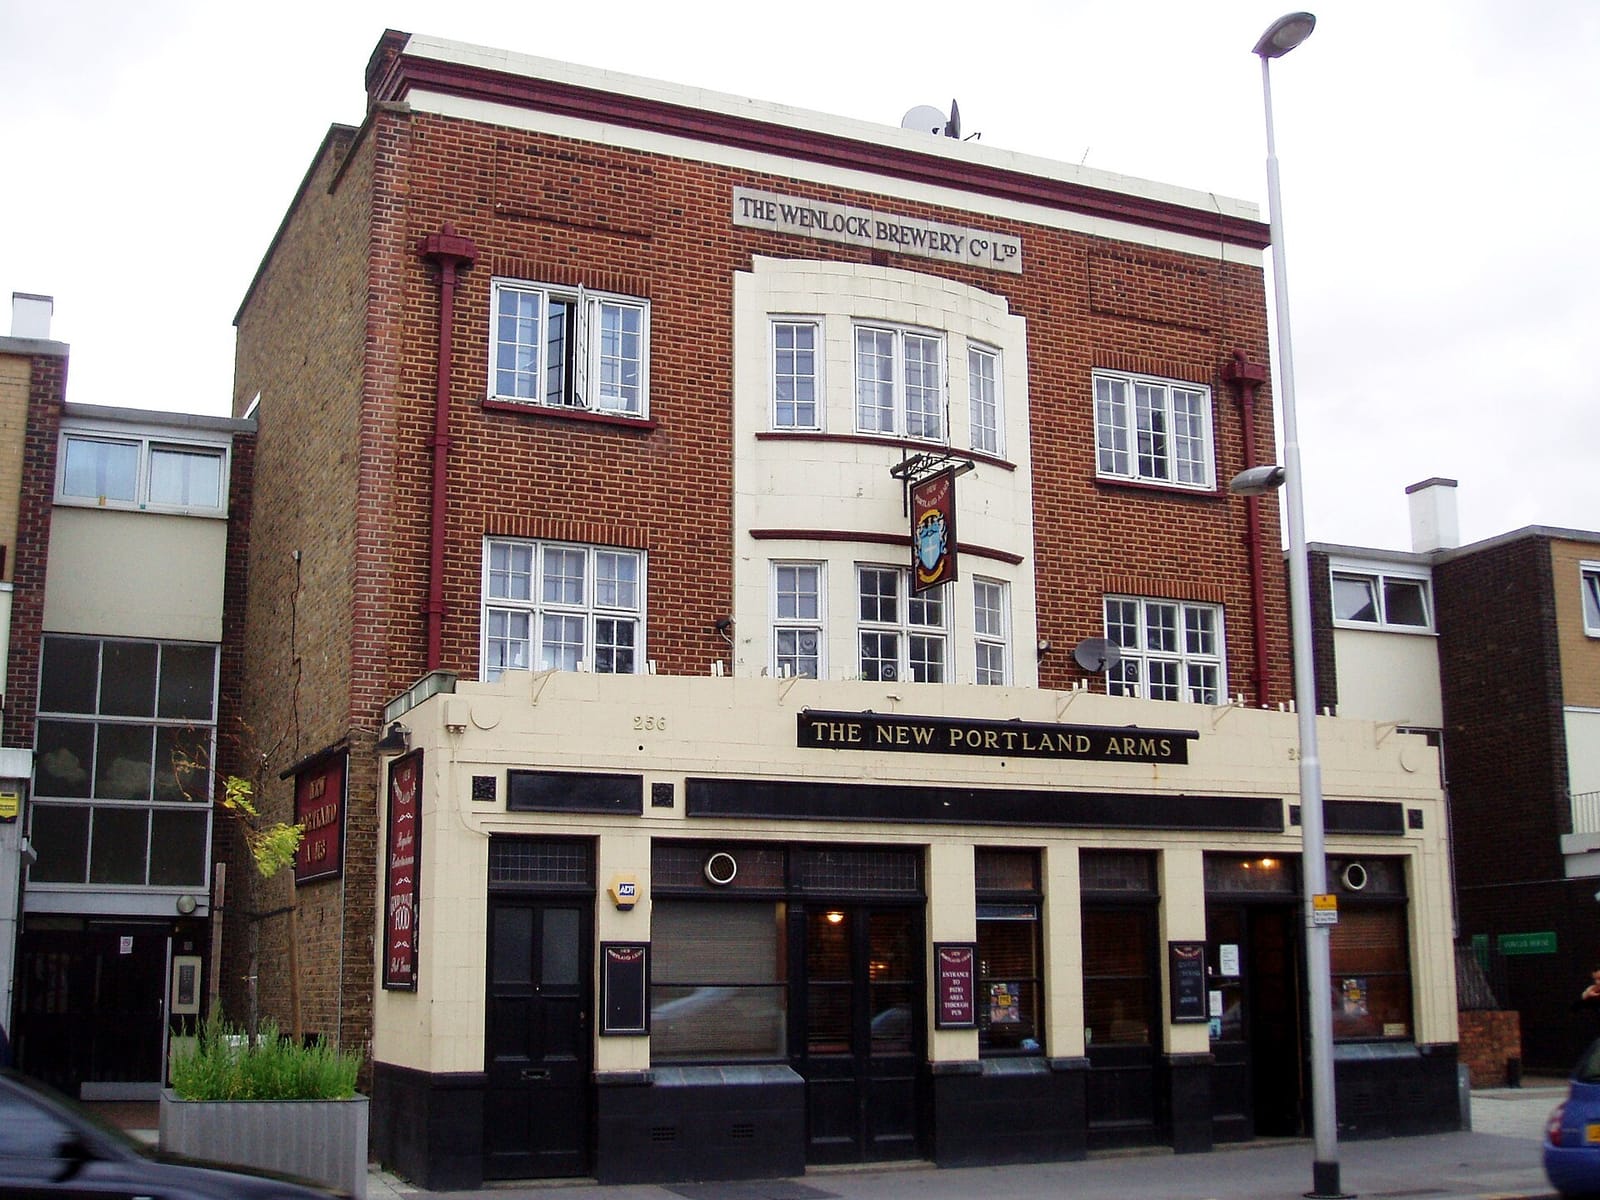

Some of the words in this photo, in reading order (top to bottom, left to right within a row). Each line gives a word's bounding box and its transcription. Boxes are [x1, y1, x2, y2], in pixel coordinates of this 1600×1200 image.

[739, 197, 777, 221] THE
[779, 204, 872, 238] WENLOCK
[876, 221, 966, 254] BREWERY
[633, 716, 666, 731] 256
[811, 721, 862, 742] THE
[876, 725, 935, 746] NEW
[949, 728, 1091, 754] PORTLAND
[1105, 736, 1172, 757] ARMS
[620, 885, 634, 894] ADT
